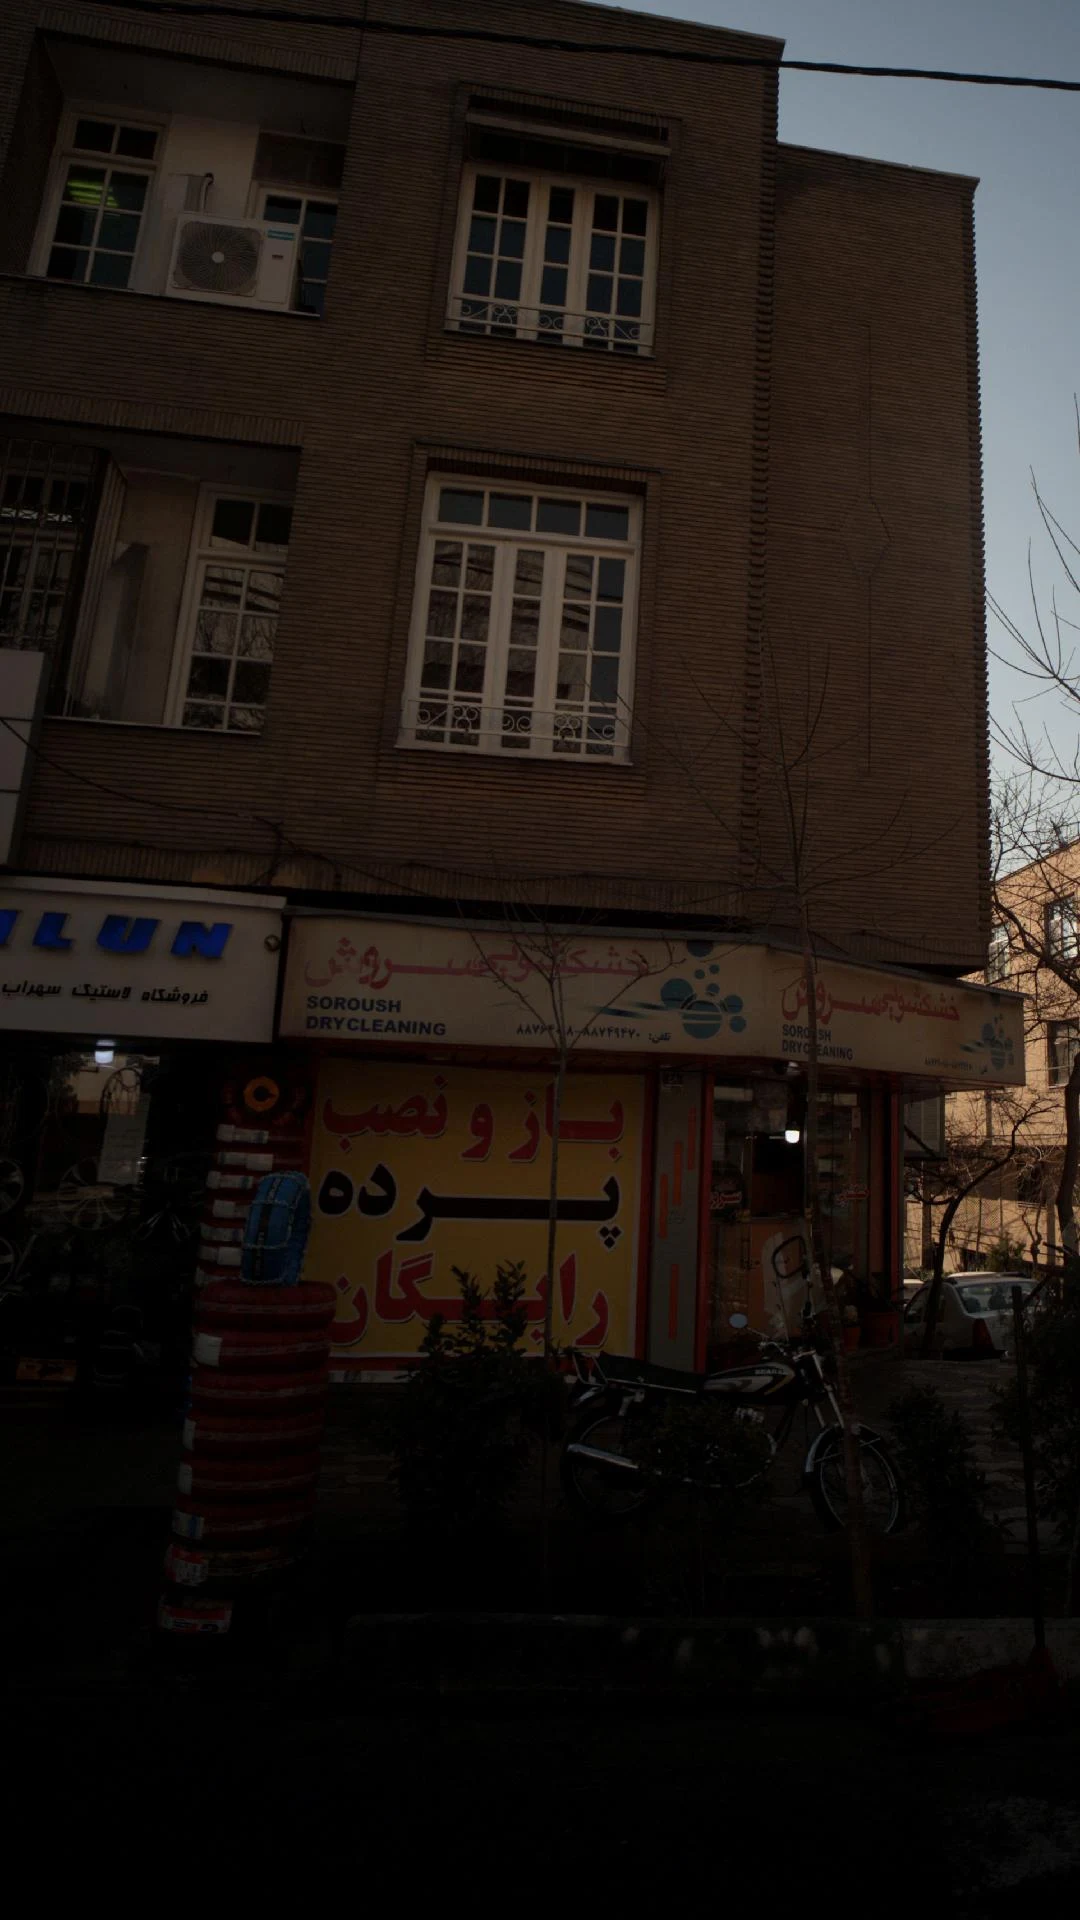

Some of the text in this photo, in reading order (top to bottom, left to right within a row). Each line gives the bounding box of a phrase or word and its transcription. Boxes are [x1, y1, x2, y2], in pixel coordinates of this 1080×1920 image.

[2, 980, 209, 1004] فروشگاه لاستیک سهراب
[306, 995, 401, 1013] SOROUSH
[306, 1015, 446, 1036] DRYCLEANING
[782, 1024, 831, 1041] SOROSH
[782, 1039, 853, 1060] DRYCEANING
[322, 1074, 624, 1161] باز و نصب
[318, 1163, 622, 1248] پرده
[329, 1250, 610, 1347] رایگان
